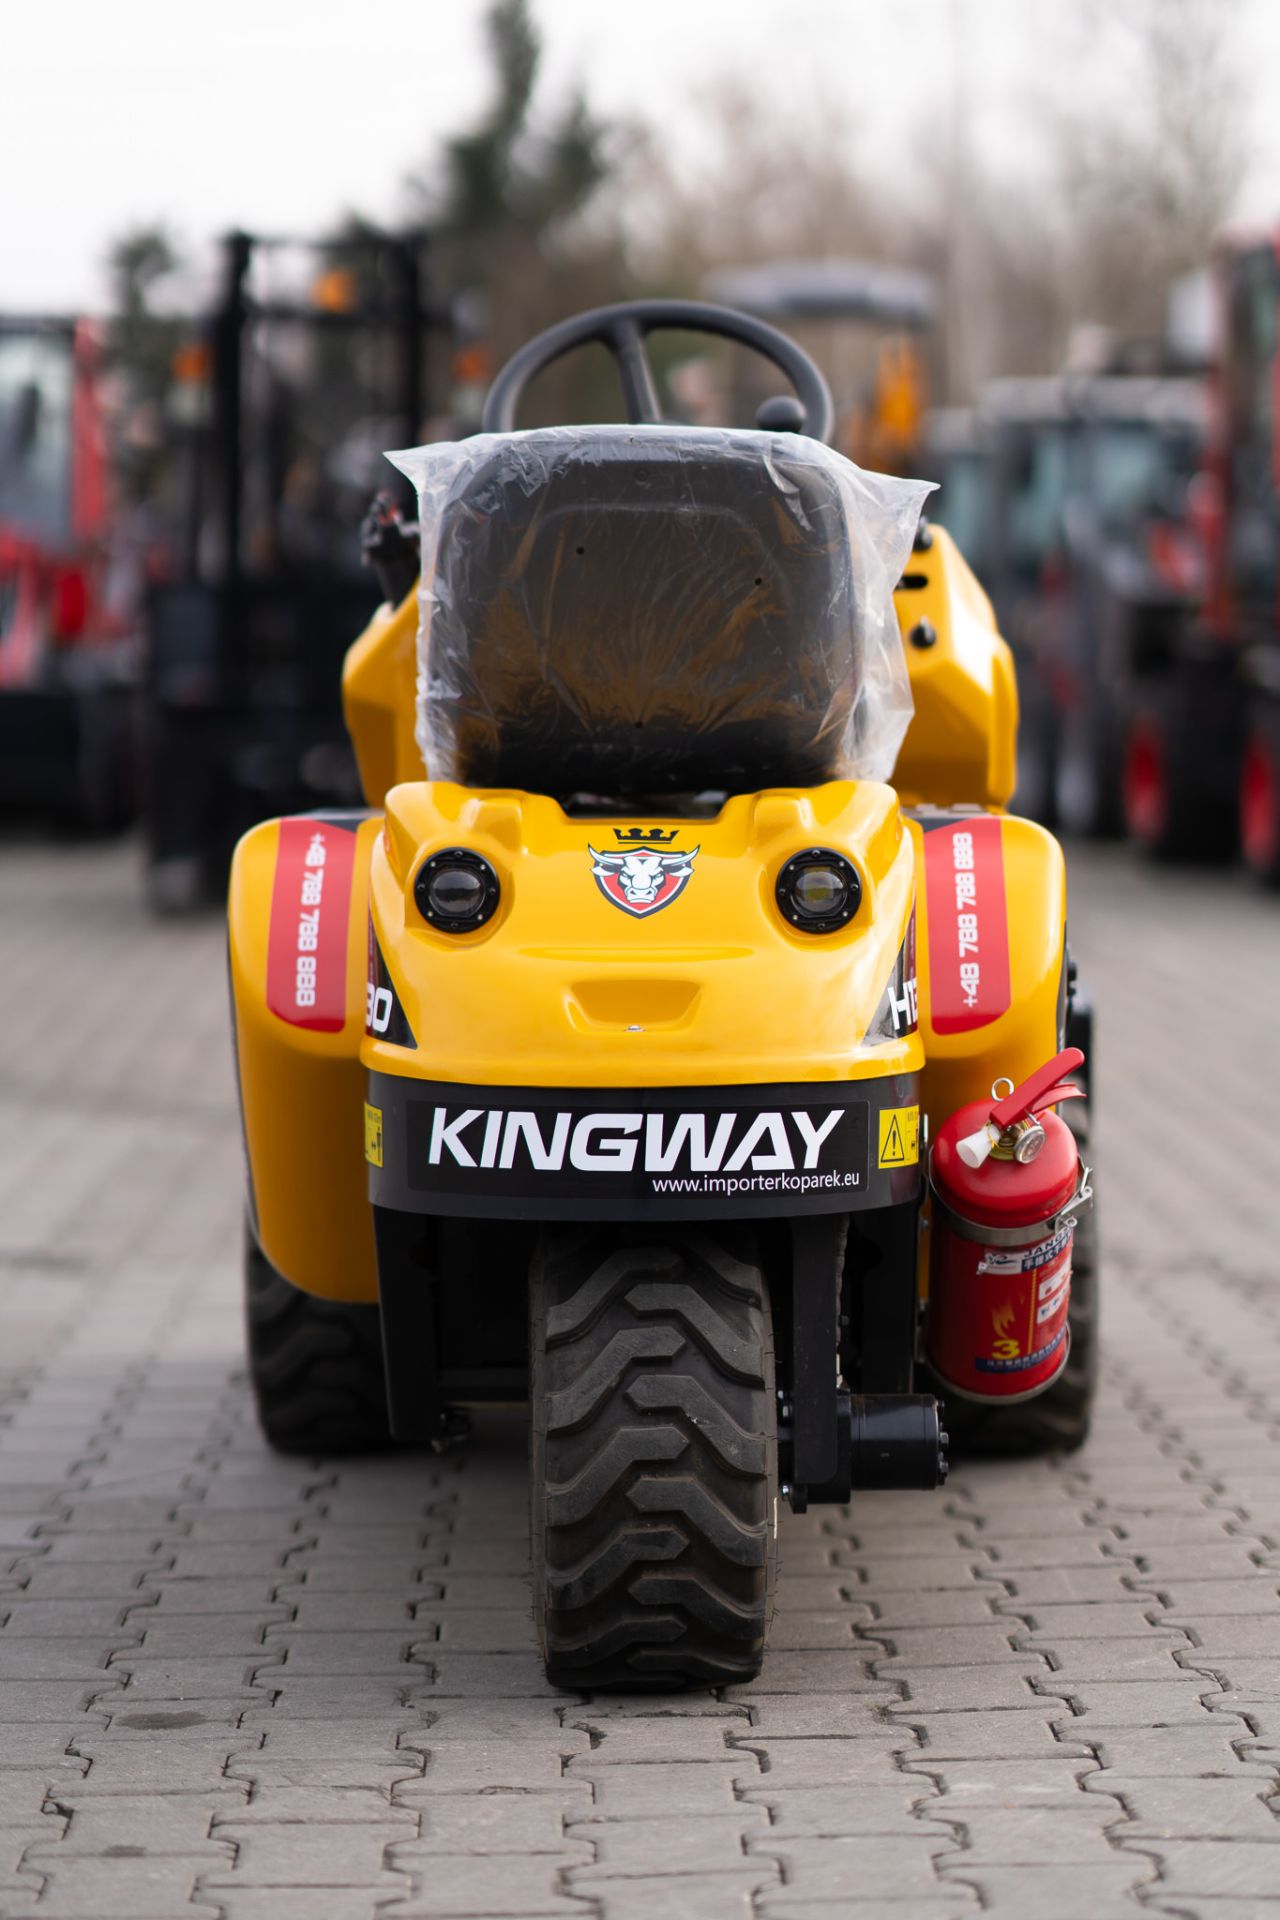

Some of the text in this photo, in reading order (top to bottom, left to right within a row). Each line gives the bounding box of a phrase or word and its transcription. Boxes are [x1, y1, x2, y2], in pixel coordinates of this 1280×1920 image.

[295, 832, 326, 1007] +48 788 788 888
[953, 832, 980, 1008] +48 788 788 888
[428, 1107, 846, 1172] KINGWAY
[652, 1170, 860, 1196] www.importerkoparek.eu
[992, 1339, 1020, 1359] 3
